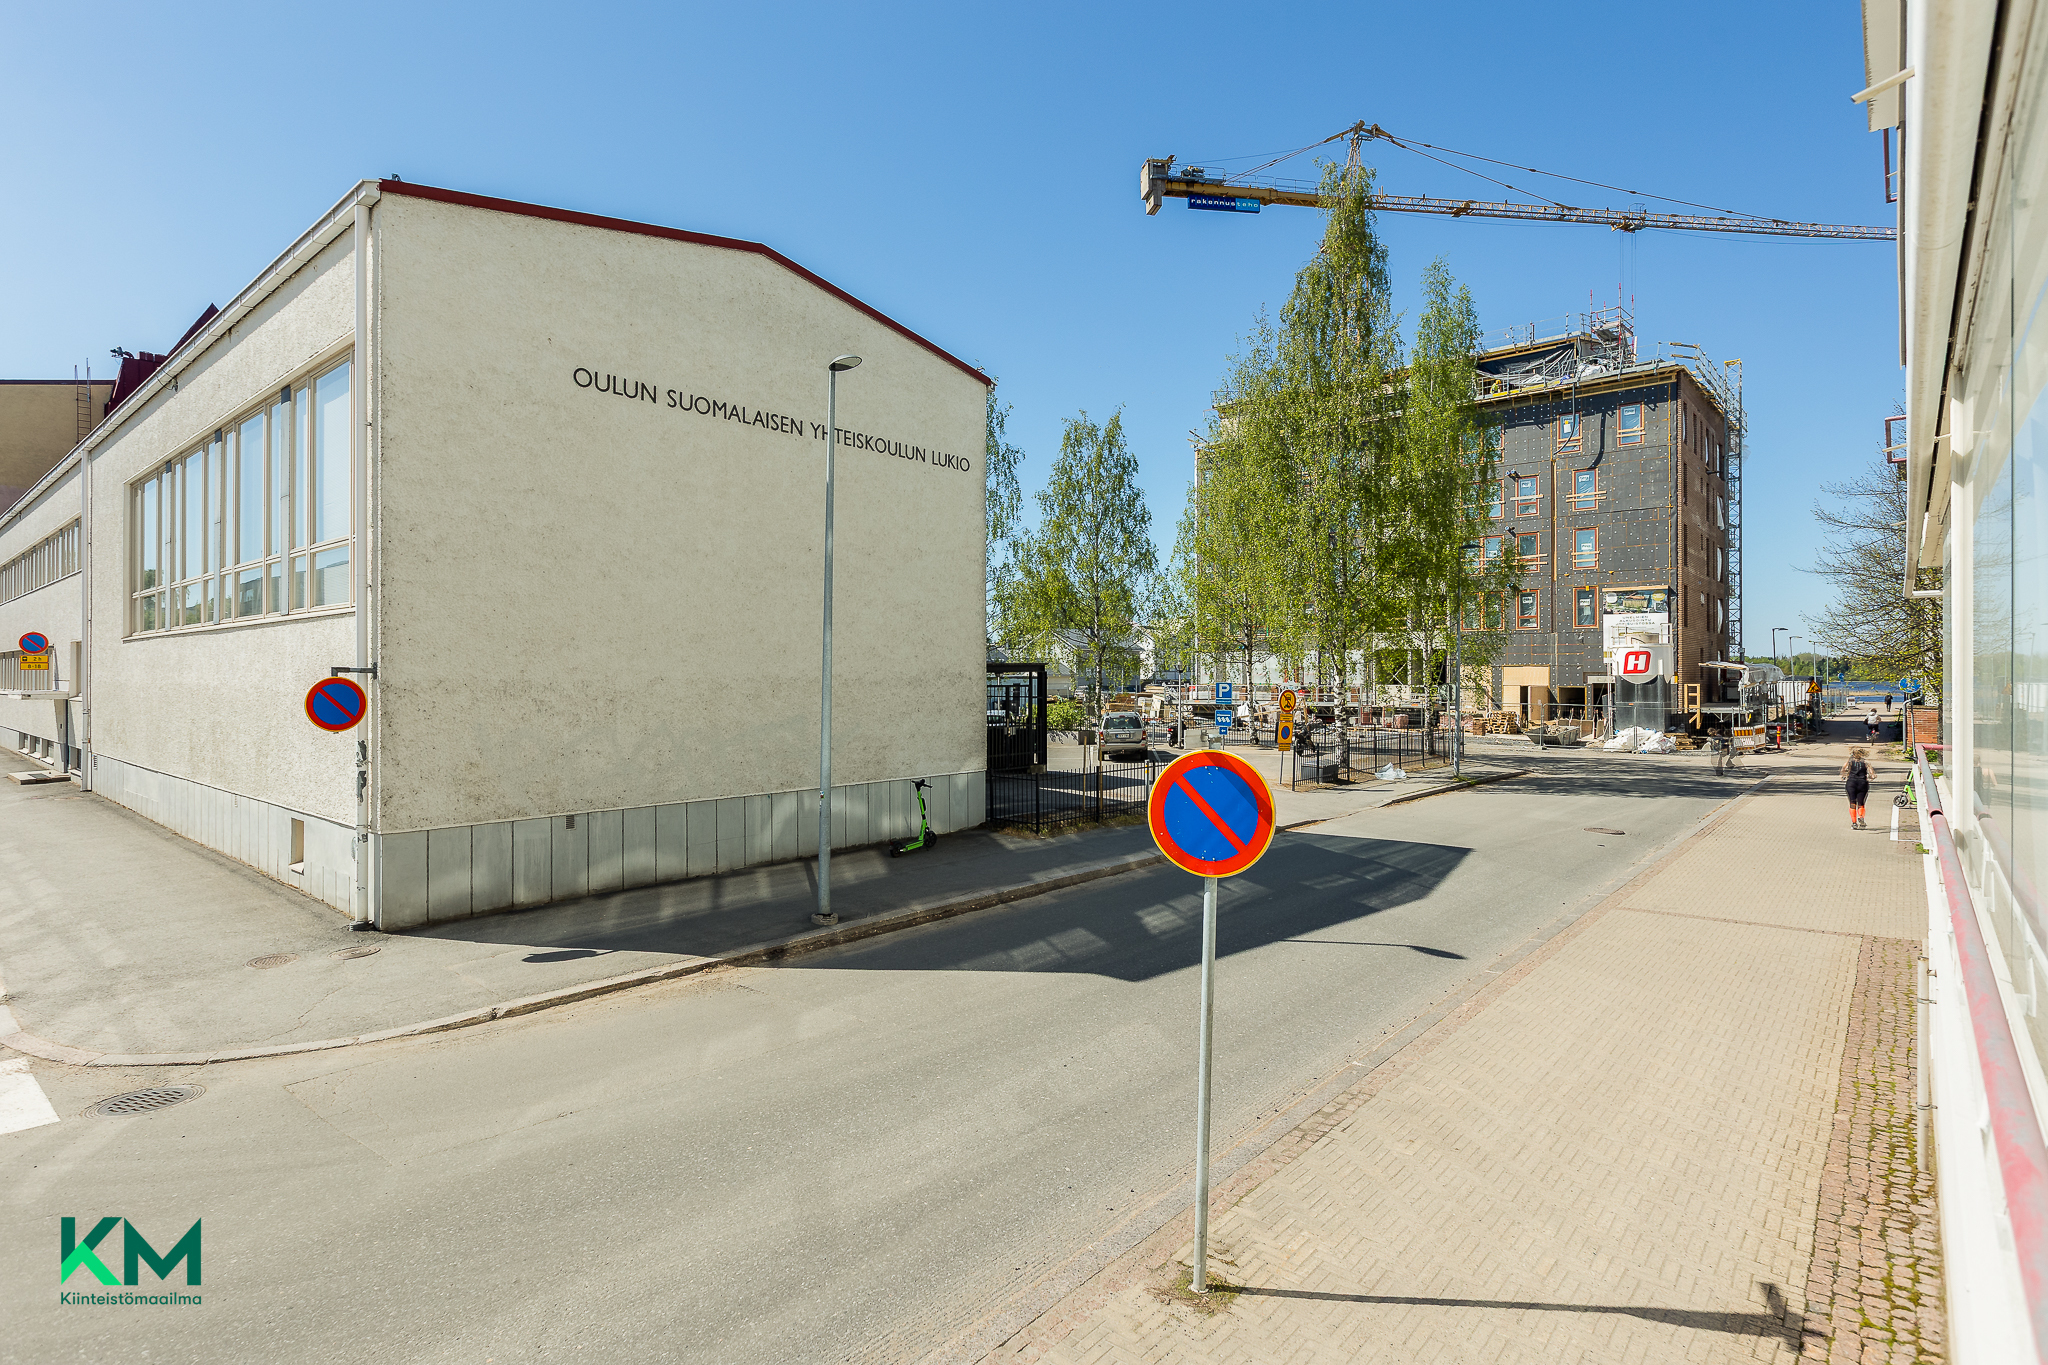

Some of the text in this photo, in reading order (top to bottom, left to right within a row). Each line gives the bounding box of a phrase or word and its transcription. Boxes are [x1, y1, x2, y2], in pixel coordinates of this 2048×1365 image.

[573, 367, 971, 473] OULUN SUOMALAISEN YHTEISKOULUN LUKIO
[1627, 654, 1647, 671] H
[1218, 683, 1230, 698] P
